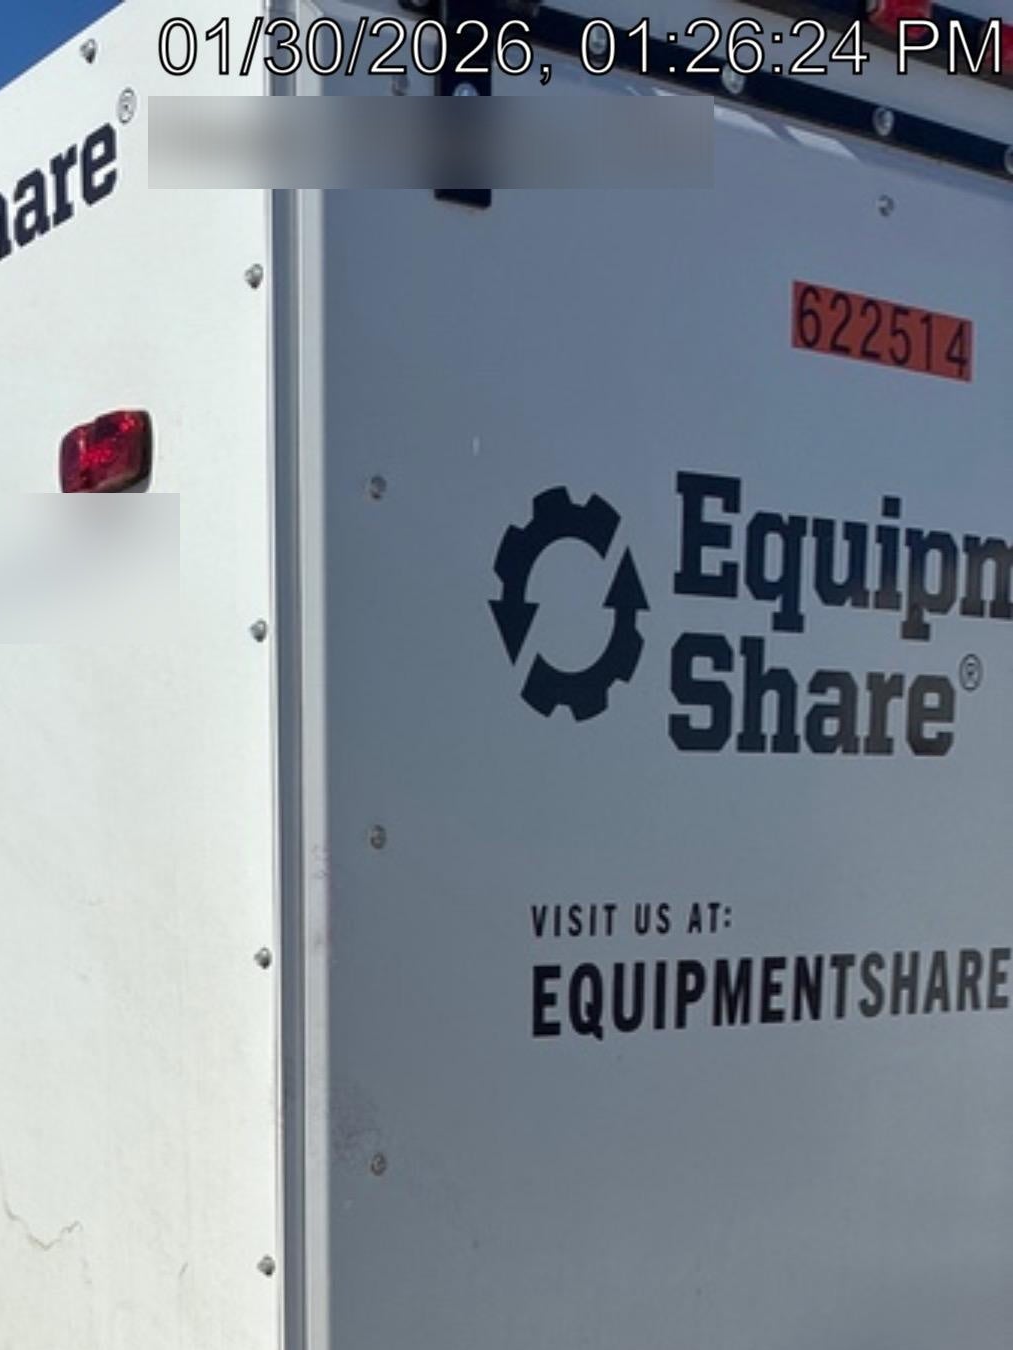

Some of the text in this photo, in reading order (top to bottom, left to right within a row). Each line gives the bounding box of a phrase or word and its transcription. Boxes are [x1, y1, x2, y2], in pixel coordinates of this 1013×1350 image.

[799, 285, 967, 377] 622514
[530, 901, 733, 938] VISIT US AT:
[531, 946, 1012, 1041] EQUIPMENTSHARE
